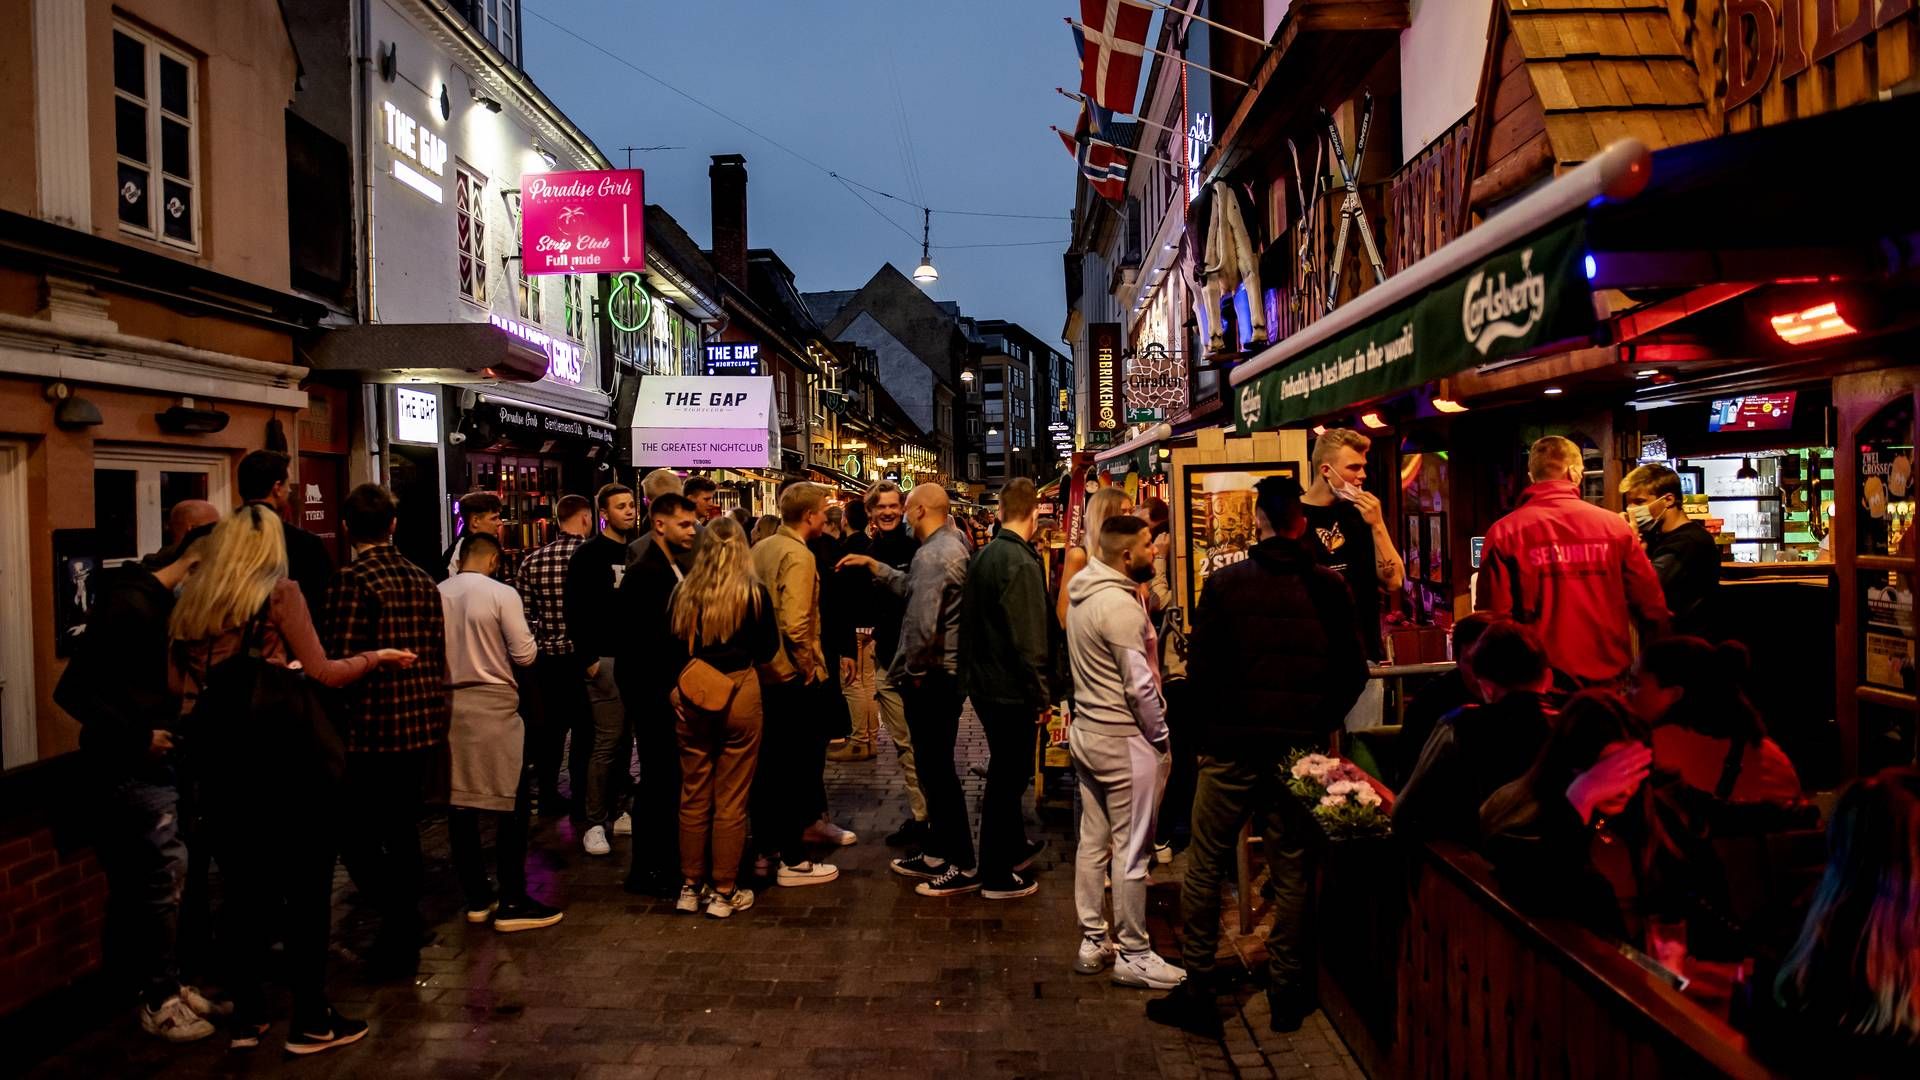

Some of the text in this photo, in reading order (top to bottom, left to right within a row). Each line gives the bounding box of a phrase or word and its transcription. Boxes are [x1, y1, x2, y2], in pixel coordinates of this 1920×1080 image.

[384, 100, 448, 177] THE GAP
[528, 176, 632, 200] Paradise Girls
[536, 235, 611, 253] Strip Club
[546, 254, 601, 267] Full nude
[1462, 271, 1545, 343] Carlsberg
[552, 338, 581, 384] GIRLS
[706, 345, 758, 360] THE GAP
[1098, 348, 1114, 407] FABRIKKEN
[1280, 371, 1310, 400] Probably
[1309, 366, 1322, 391] the
[1322, 362, 1338, 387] best
[1337, 355, 1355, 382] beer
[1354, 349, 1366, 375] in
[1366, 340, 1384, 371] the
[400, 395, 435, 421] THE GAP
[665, 392, 748, 407] THE GAP
[641, 442, 763, 452] THE GREATEST NIGHTCLUB
[1862, 452, 1879, 464] ZWEI
[1069, 504, 1080, 546] TYROLIA
[1199, 557, 1210, 576] 2
[1212, 549, 1249, 572] STO
[1529, 543, 1609, 566] SECURITY
